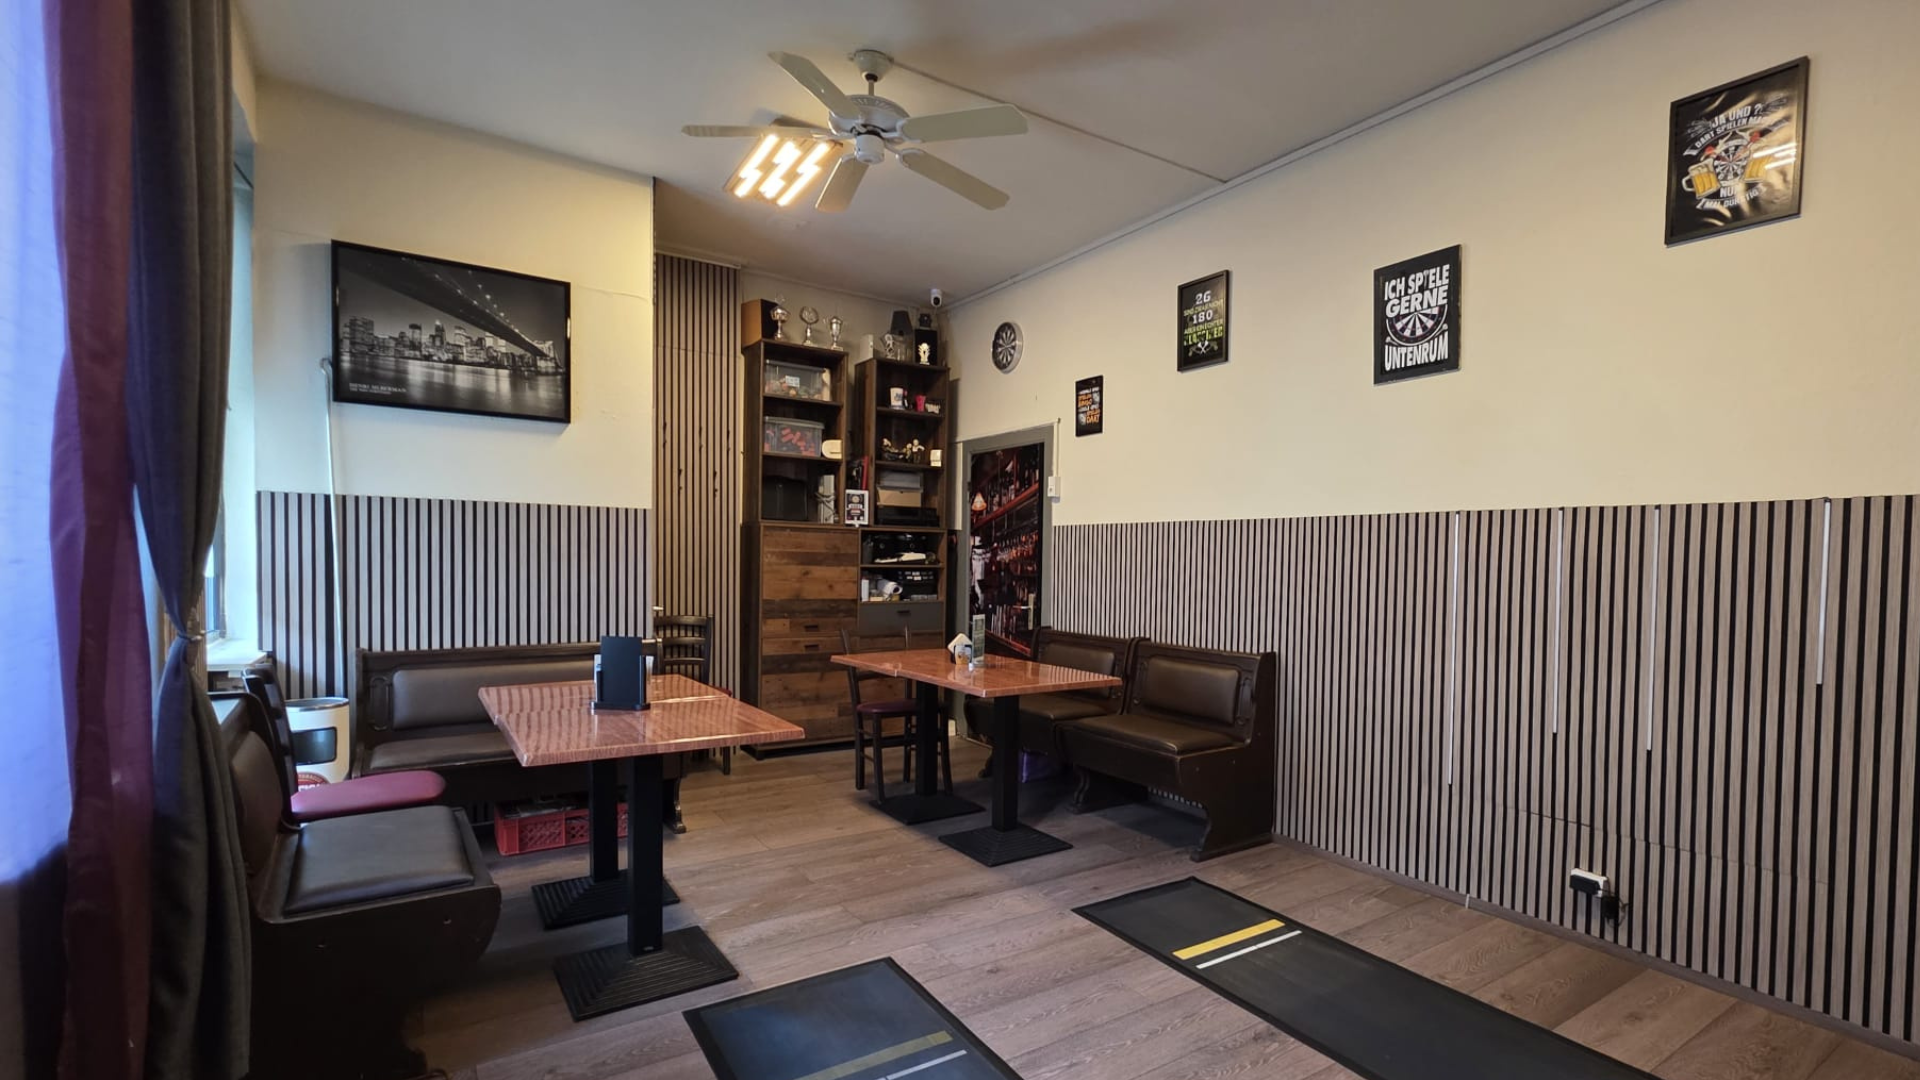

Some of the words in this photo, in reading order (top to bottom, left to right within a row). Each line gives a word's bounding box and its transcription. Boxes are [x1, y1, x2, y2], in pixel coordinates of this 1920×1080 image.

[1712, 114, 1727, 128] JA
[1729, 106, 1751, 121] UND
[1695, 131, 1715, 148] DART
[1716, 118, 1748, 134] SPIELEN
[1384, 276, 1406, 301] ICH
[1386, 285, 1449, 318] GERNE
[1192, 309, 1213, 325] 180
[1384, 331, 1449, 371] UNTENRUM
